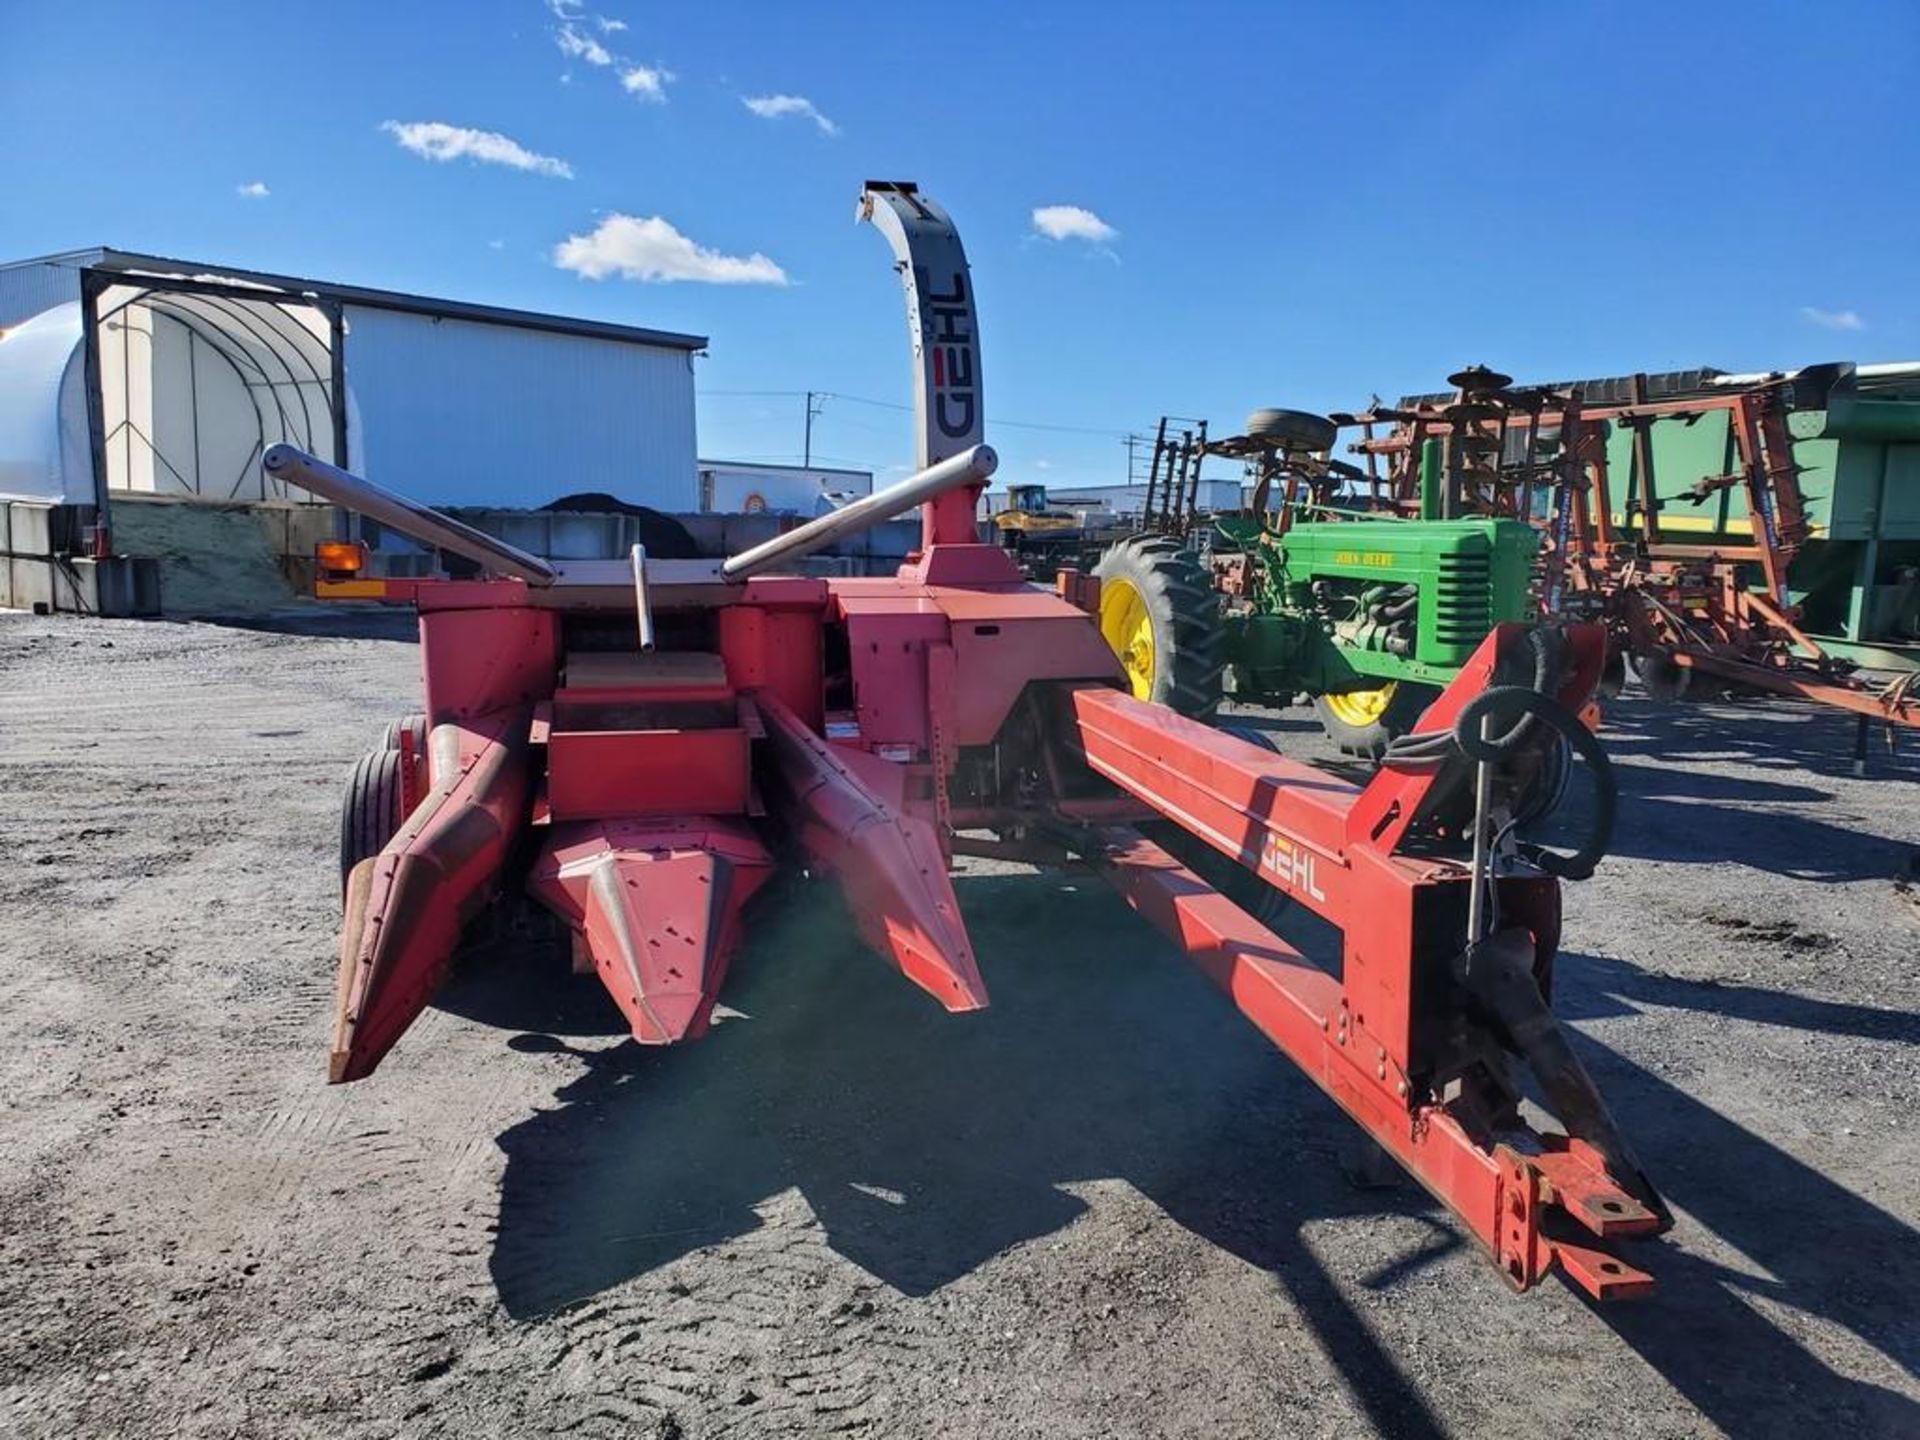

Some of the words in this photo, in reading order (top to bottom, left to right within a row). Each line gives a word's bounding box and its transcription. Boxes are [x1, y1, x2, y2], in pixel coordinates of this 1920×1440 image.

[929, 272, 975, 438] GEHL
[1335, 551, 1360, 566] JOHN
[1362, 552, 1395, 568] DEERE
